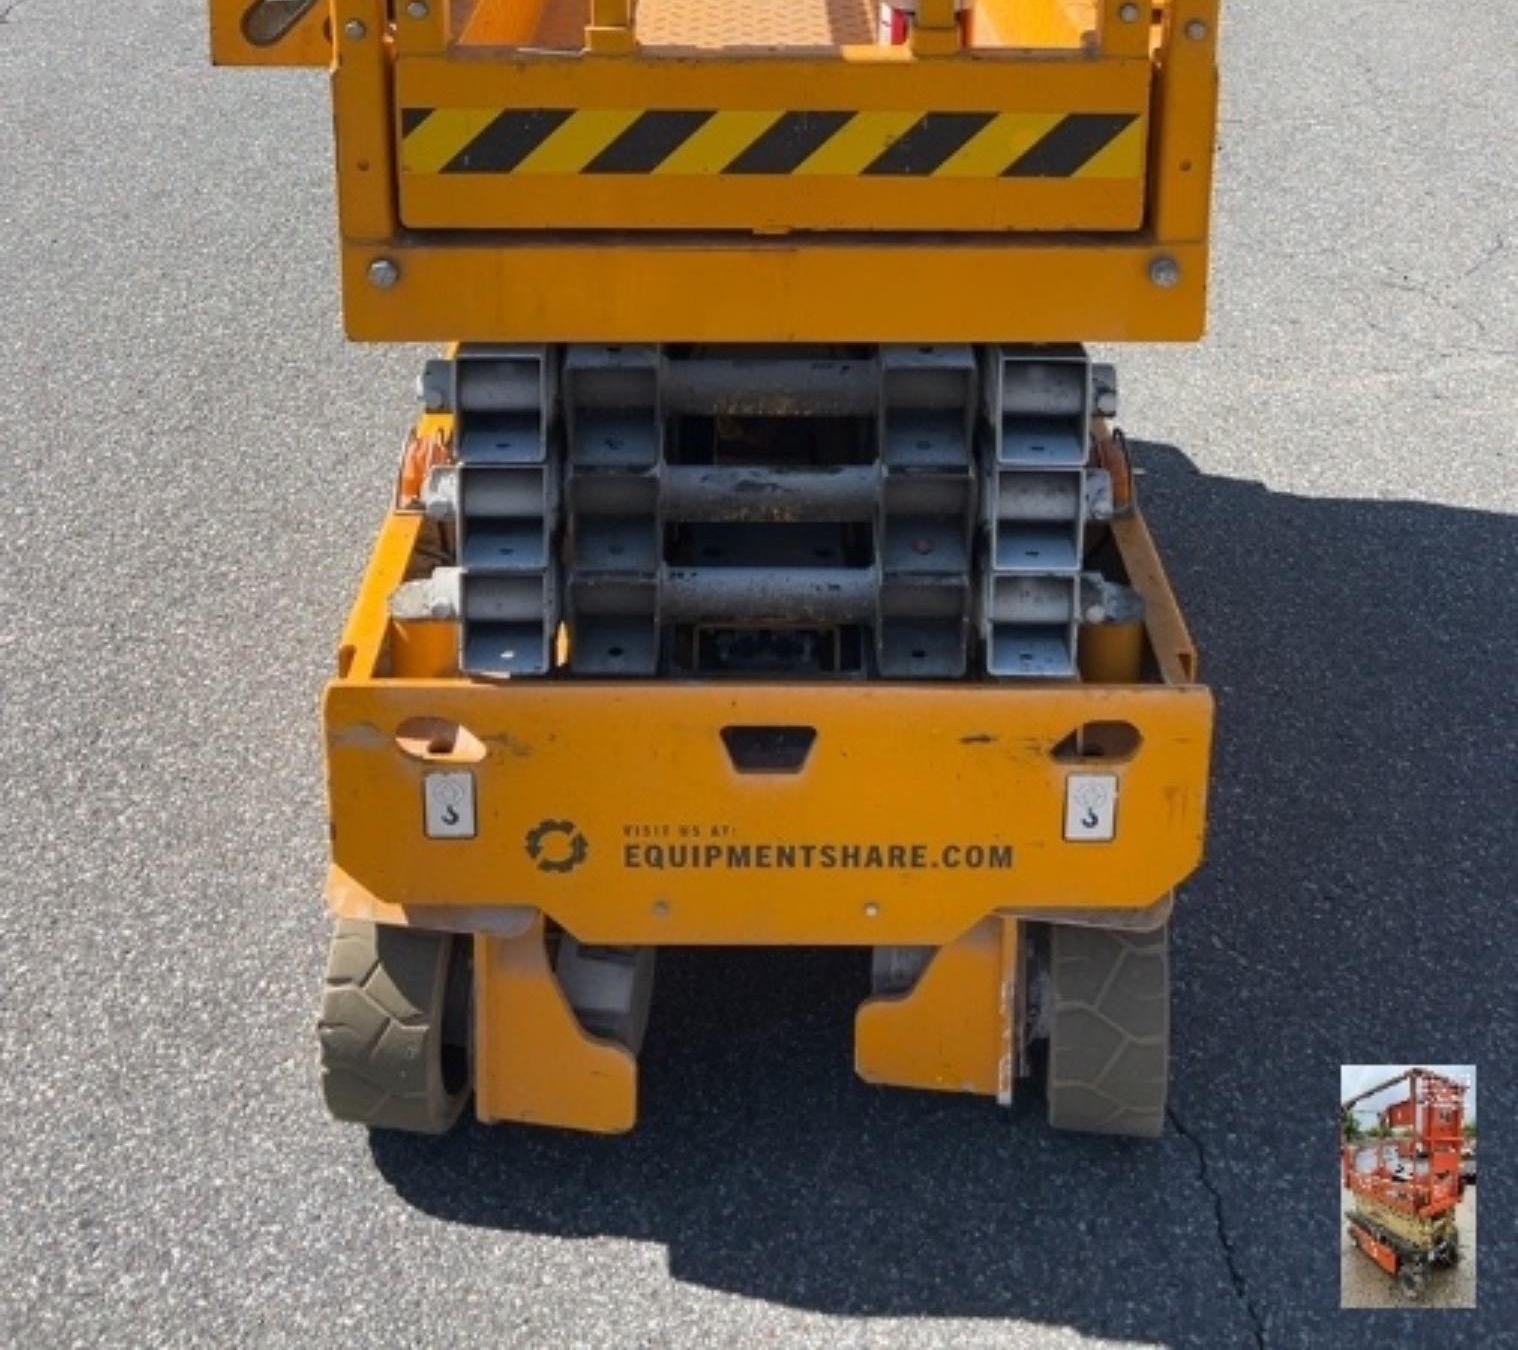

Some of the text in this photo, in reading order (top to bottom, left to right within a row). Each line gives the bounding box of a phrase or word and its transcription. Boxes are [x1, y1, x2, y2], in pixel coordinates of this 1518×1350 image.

[624, 824, 670, 838] VISIT
[679, 824, 701, 838] US
[623, 844, 1014, 870] EQUIPMENTSHARE.COM
